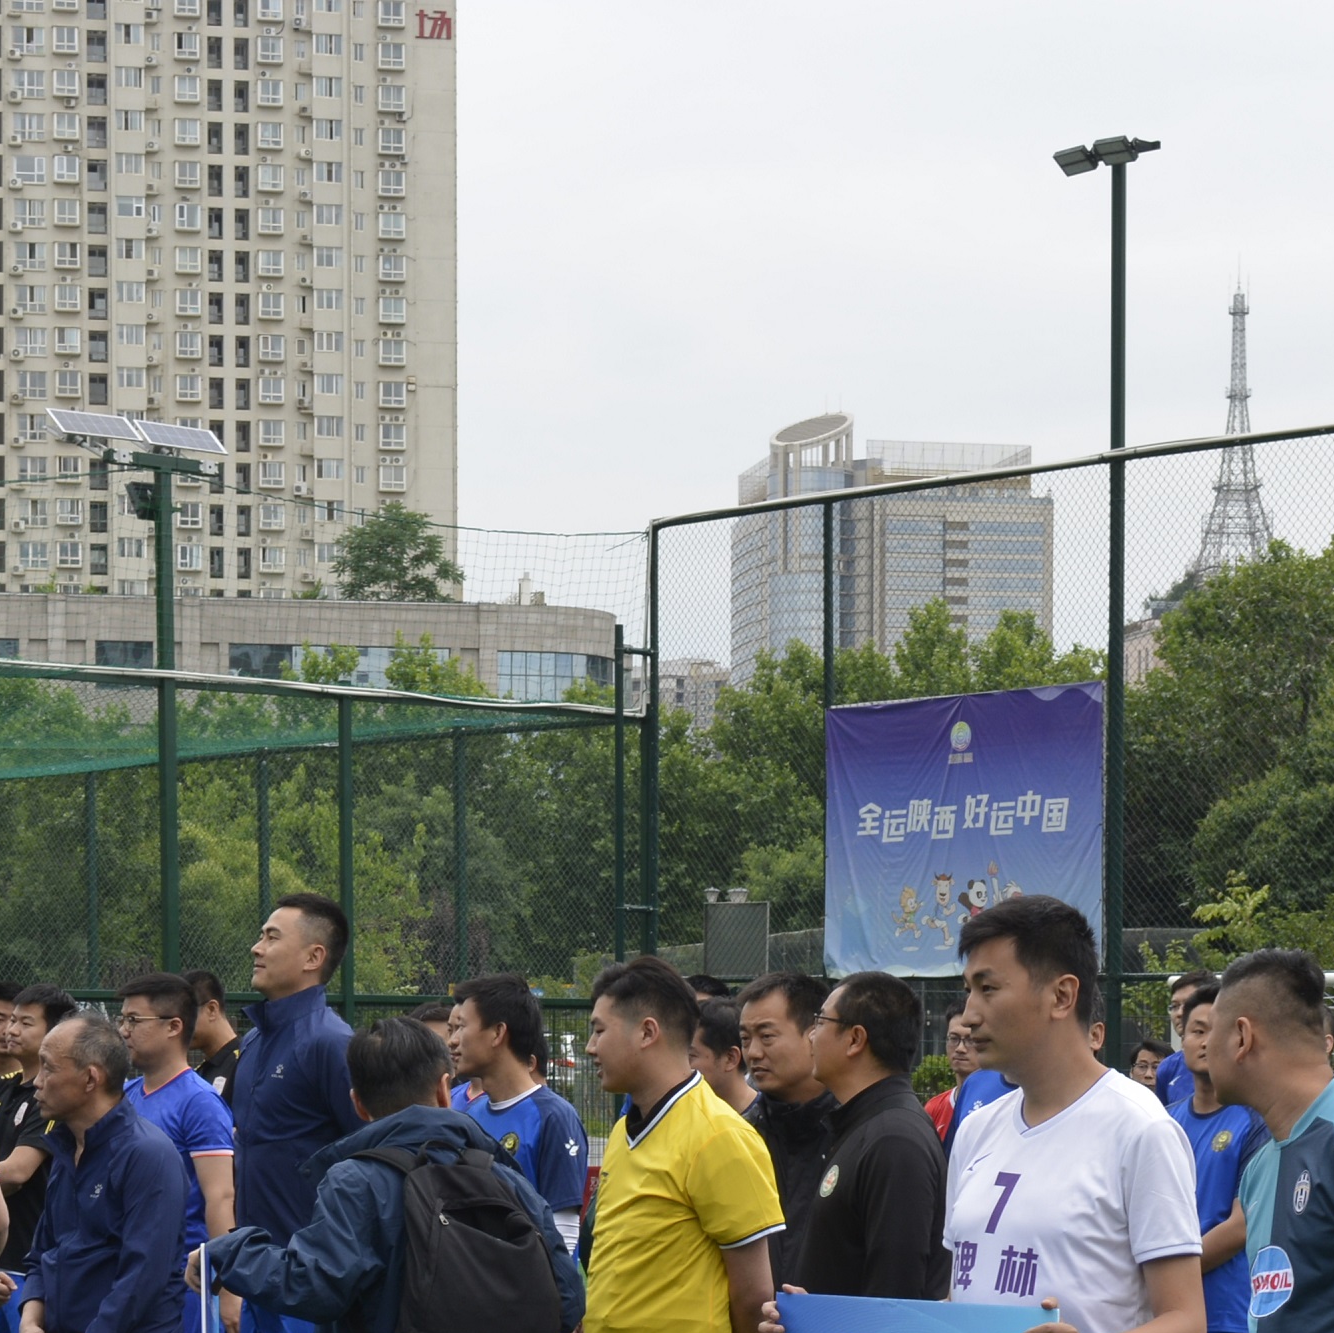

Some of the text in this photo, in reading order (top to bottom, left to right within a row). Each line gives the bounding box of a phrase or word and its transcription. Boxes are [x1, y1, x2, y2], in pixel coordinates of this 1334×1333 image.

[857, 790, 1069, 843] 全运陕西 好运中国
[985, 1171, 1022, 1235] 7
